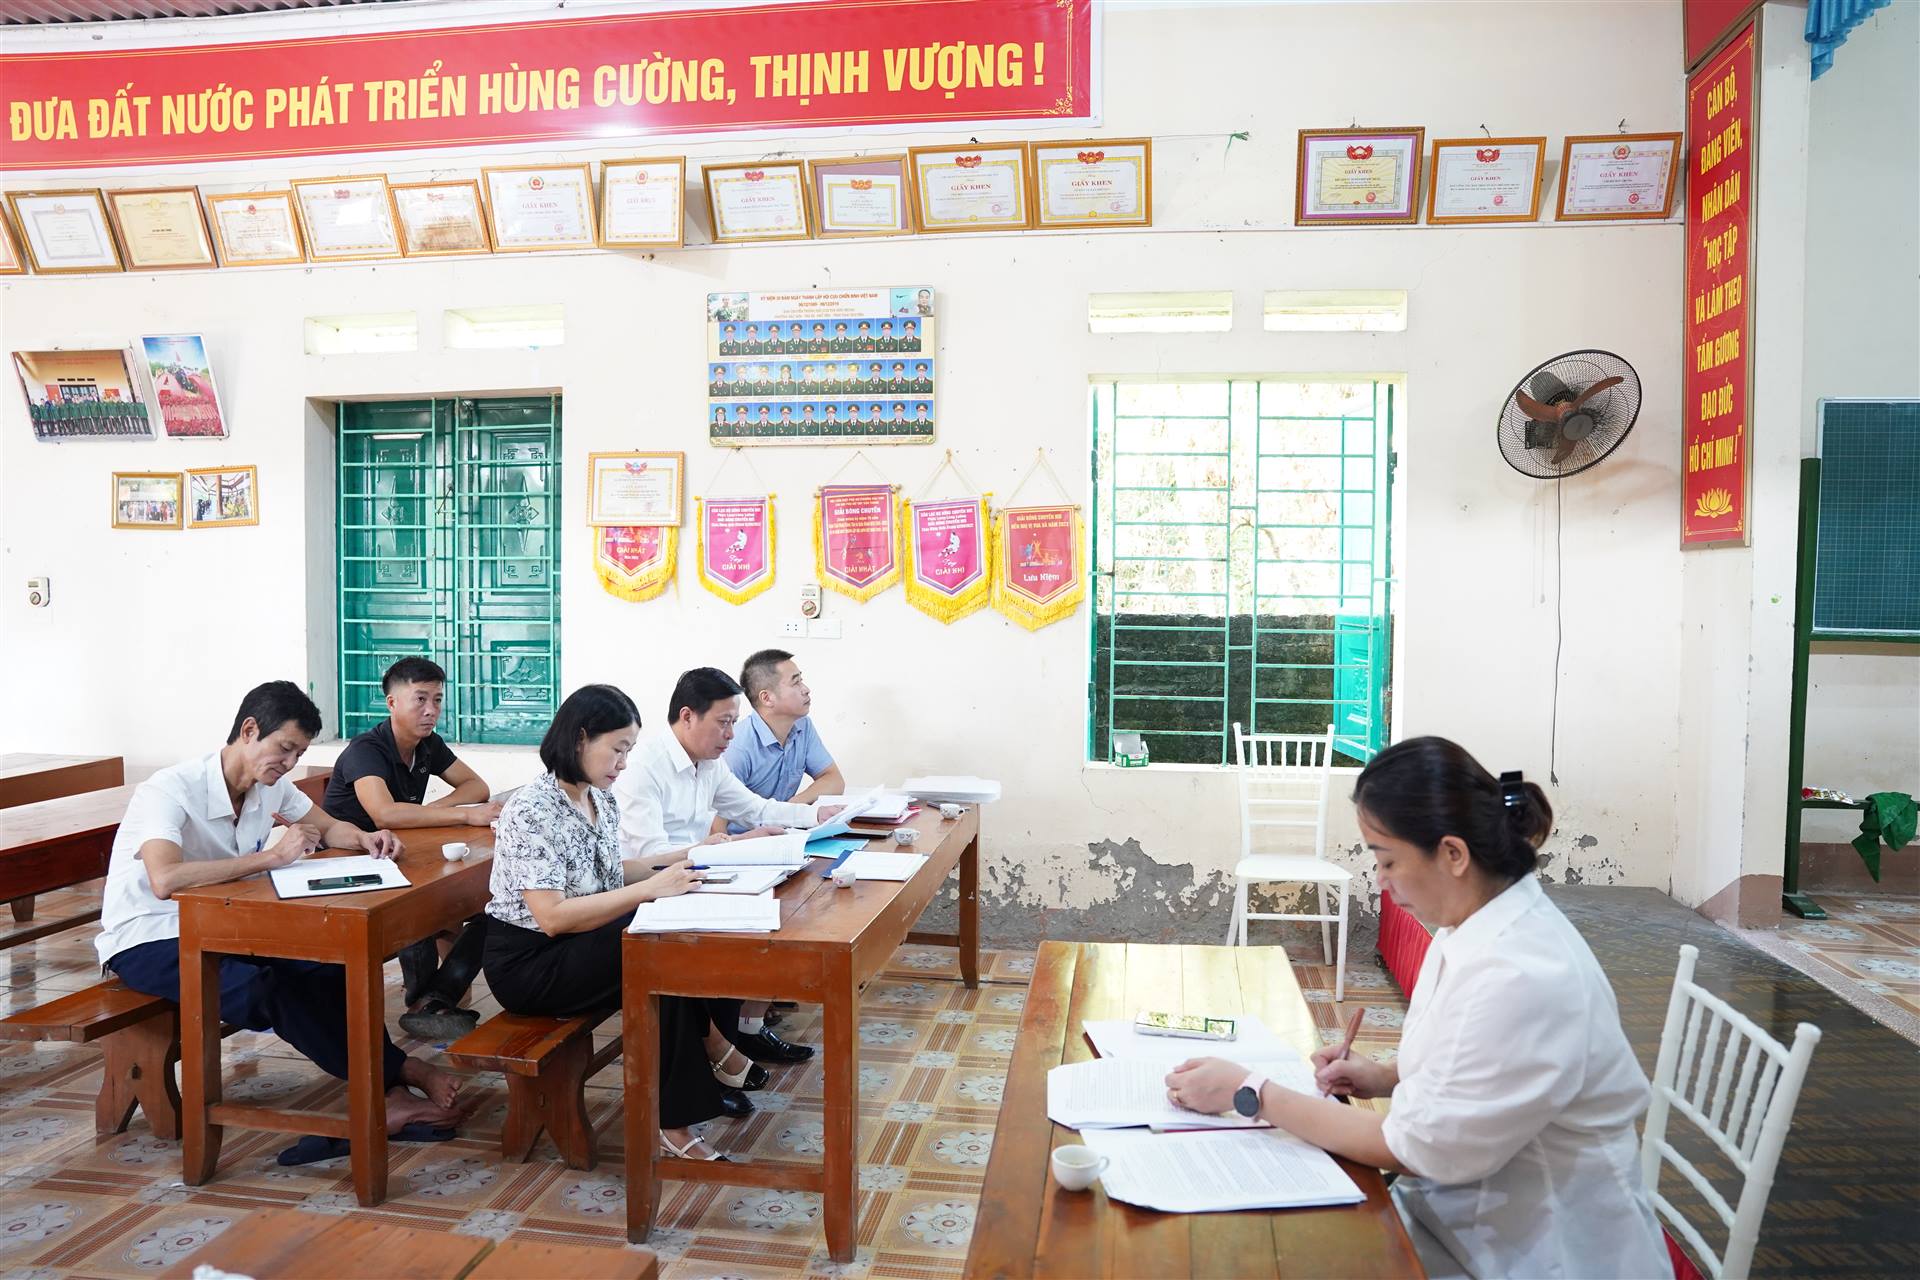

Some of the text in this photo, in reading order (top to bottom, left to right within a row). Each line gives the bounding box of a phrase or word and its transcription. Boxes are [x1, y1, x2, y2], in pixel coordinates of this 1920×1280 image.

[10, 41, 1045, 142] ĐƯA ĐẤT NƯỚC PHÁT TRIỂN HÙNG CƯỜNG, THỊNH VƯỢNG !
[1707, 65, 1737, 120] CÁN BỘ,
[1700, 117, 1743, 175] ĐẢNG VIÊN,
[970, 182, 992, 190] KHEN
[1702, 169, 1740, 223] NHÂN DÂN
[1723, 222, 1738, 264] TẬP
[1695, 273, 1742, 325] VÀ LÀM THEO
[1696, 329, 1739, 373] TẤM GƯƠNG
[1717, 376, 1734, 417] ĐỨC
[1689, 433, 1699, 472] HỒ
[1700, 433, 1714, 470] CHÍ
[1715, 434, 1734, 468] MINH
[935, 566, 951, 576] GIẢI
